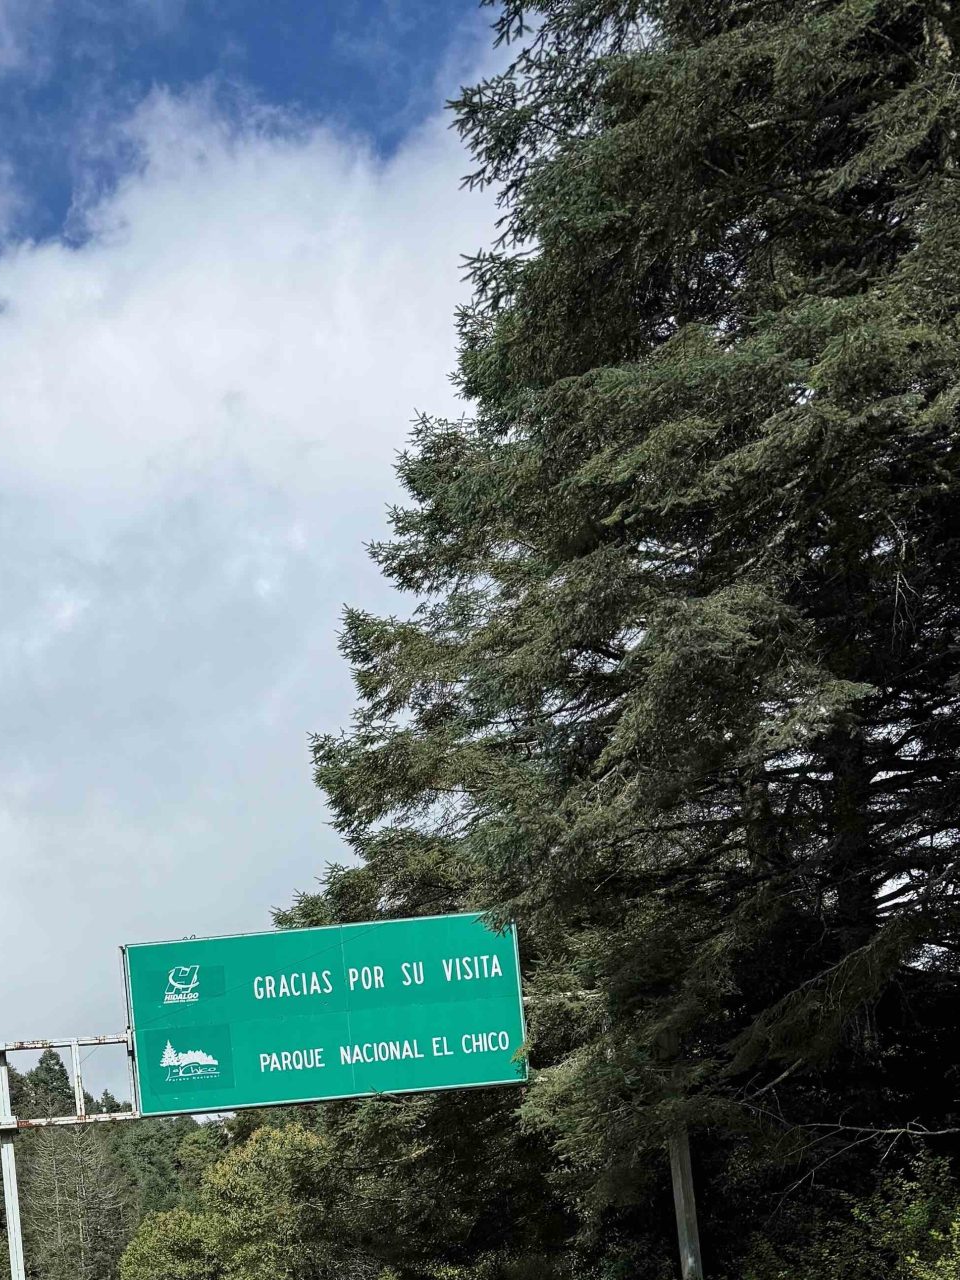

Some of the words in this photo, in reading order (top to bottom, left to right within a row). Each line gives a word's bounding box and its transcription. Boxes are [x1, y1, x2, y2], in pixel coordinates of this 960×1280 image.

[164, 992, 199, 1001] HIDALGO
[253, 970, 333, 999] GRACIAS
[348, 965, 385, 991] POR
[401, 961, 424, 986] SU
[442, 954, 503, 982] VISITA
[259, 1048, 325, 1072] PARQUE
[339, 1039, 424, 1065] NACIONAL
[432, 1036, 454, 1057] EL
[461, 1031, 510, 1054] CHICO
